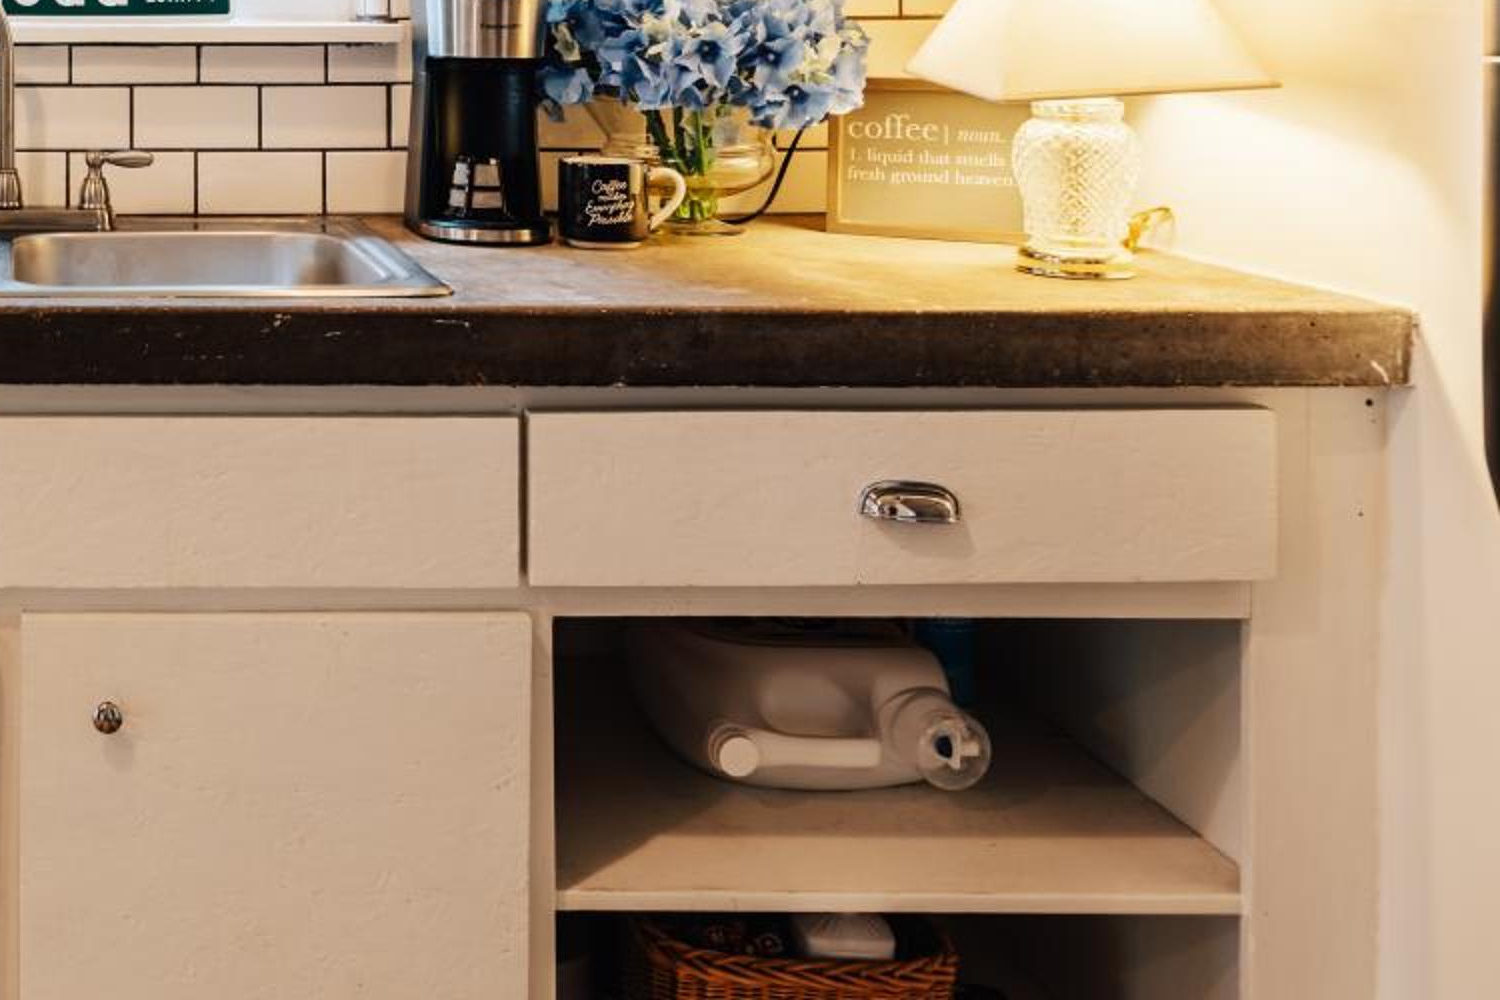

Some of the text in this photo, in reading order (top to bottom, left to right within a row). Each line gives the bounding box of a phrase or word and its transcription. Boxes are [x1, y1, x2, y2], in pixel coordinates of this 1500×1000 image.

[849, 113, 939, 141] coffee
[868, 147, 913, 166] liquid
[919, 150, 949, 165] that
[848, 167, 885, 182] fresh
[891, 169, 949, 185] ground
[591, 179, 627, 196] Coffee
